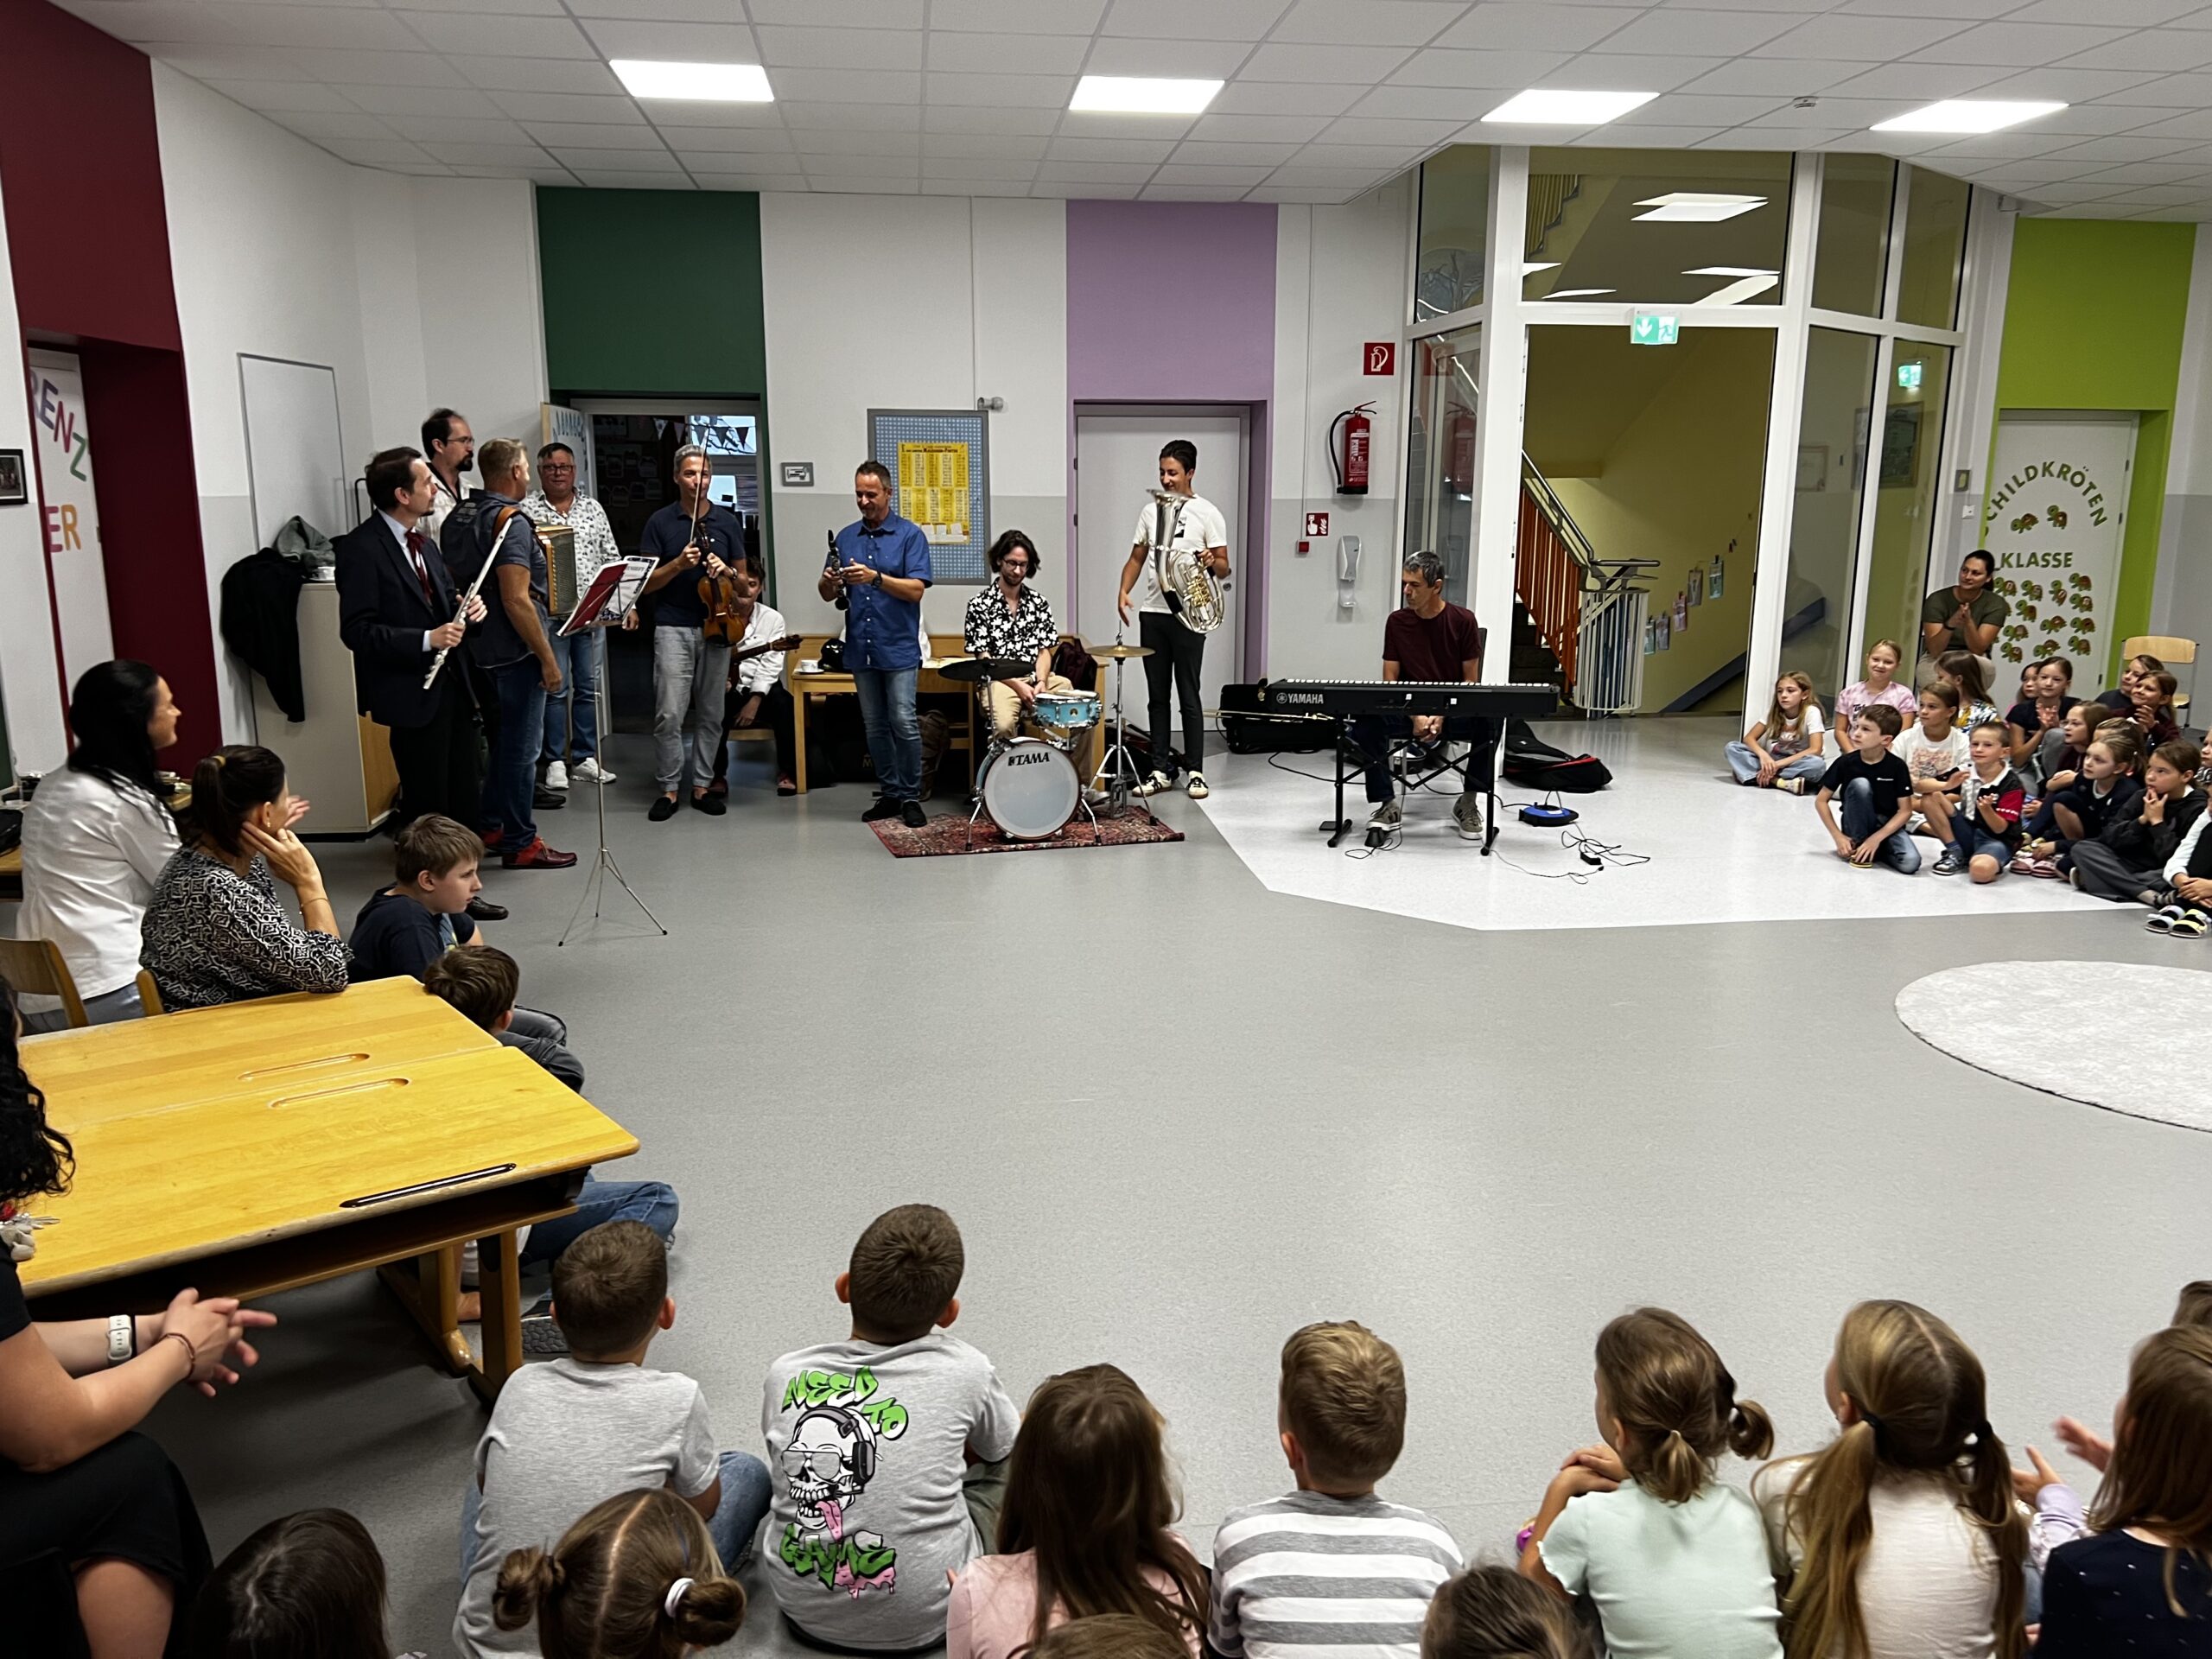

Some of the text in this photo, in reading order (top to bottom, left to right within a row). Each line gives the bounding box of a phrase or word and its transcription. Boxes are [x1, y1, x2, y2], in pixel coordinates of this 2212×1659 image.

[1984, 461, 2108, 537] CHILDKRÖTEN
[2000, 551, 2074, 569] KLASSE
[1287, 693, 1324, 704] YAMAHA
[1015, 752, 1051, 766] TAMA
[781, 1366, 879, 1413] NEED
[861, 1397, 909, 1441] TO
